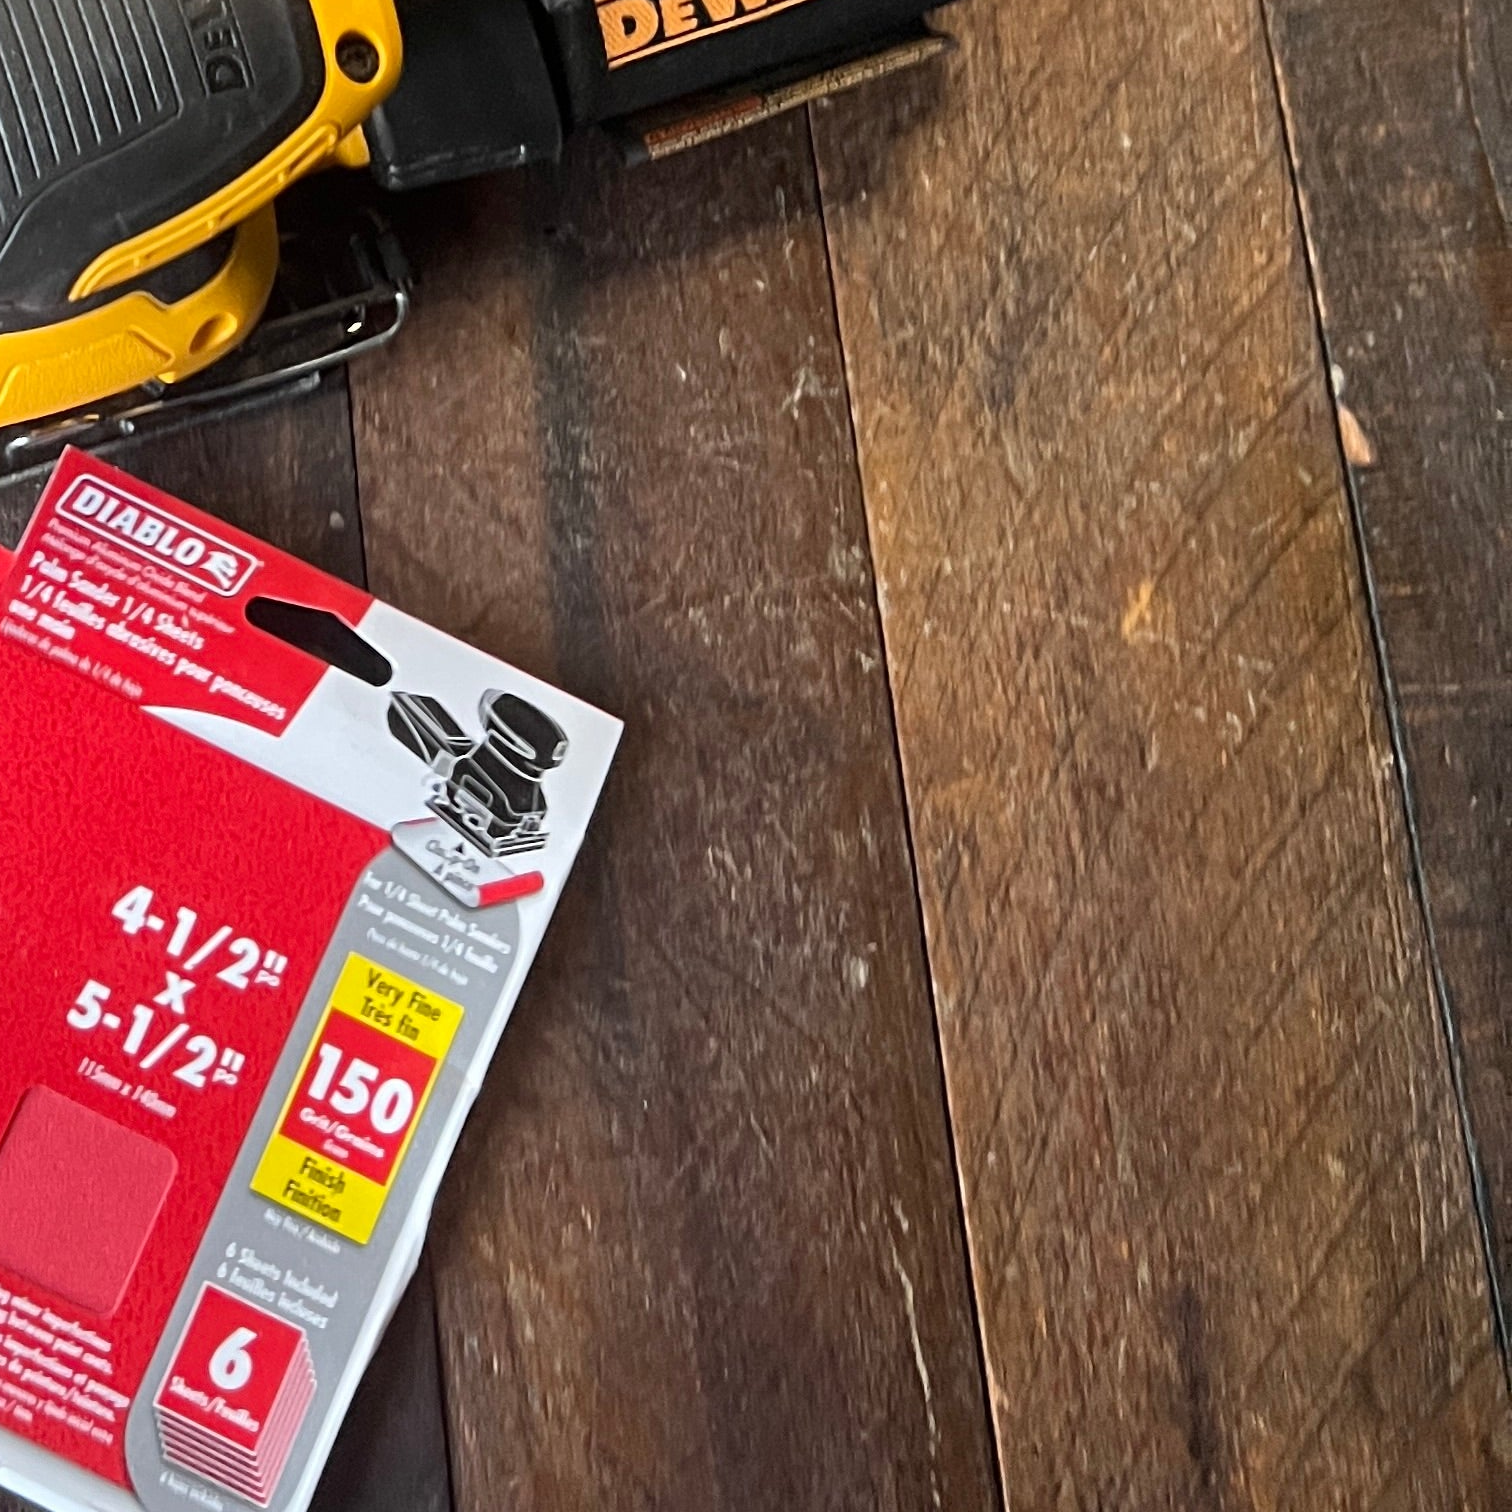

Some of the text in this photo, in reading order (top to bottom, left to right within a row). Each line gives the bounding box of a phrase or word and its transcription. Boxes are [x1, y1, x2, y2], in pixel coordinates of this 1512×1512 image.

[72, 485, 205, 565] DIABLO
[28, 550, 68, 582] Palm
[68, 570, 120, 607] Sander
[121, 596, 155, 624] 1/4
[20, 574, 54, 603] 1/4
[173, 657, 213, 682] pour
[367, 967, 441, 1022] Very Fine
[395, 1013, 420, 1041] fin
[308, 1043, 413, 1134] 150
[282, 1178, 342, 1222] Finition
[298, 1156, 346, 1194] Finish
[208, 1326, 257, 1390] 6
